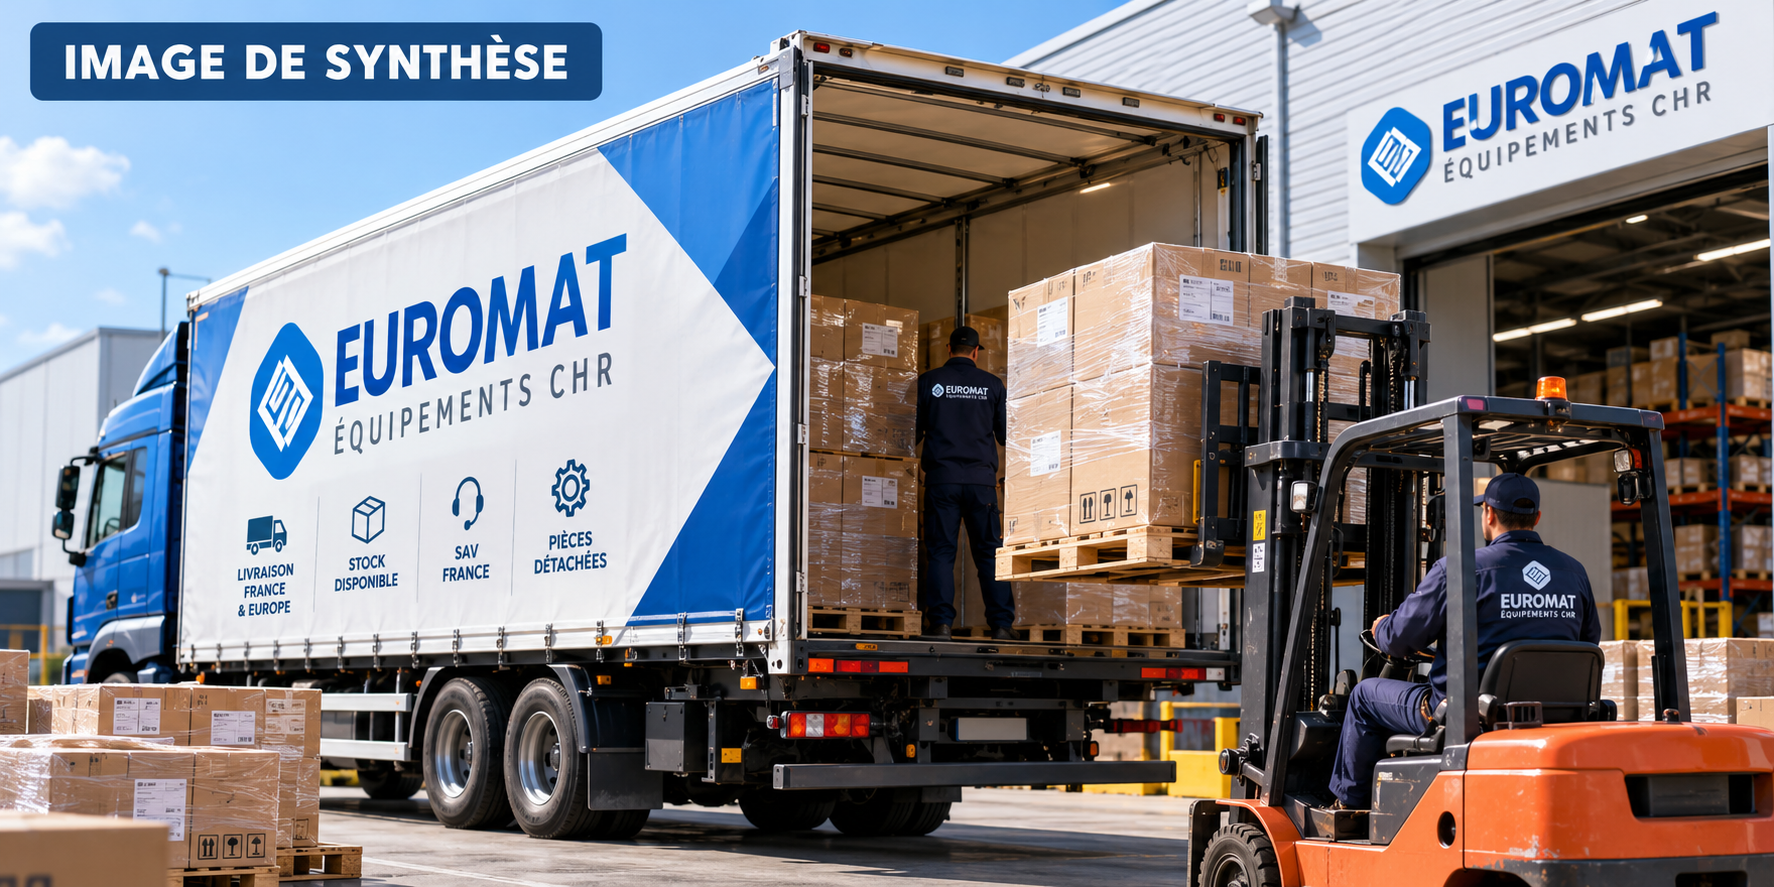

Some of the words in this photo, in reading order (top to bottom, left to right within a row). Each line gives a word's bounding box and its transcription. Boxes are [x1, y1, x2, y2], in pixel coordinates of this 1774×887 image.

[1442, 11, 1719, 153] EUROMAT
[1443, 104, 1635, 183] ÉQUIPEMENTS
[1652, 82, 1711, 117] CHR
[335, 233, 627, 408] EUROMAT
[945, 385, 988, 396] EUROMAT
[333, 373, 531, 455] ÉQUIPEMENTS
[551, 353, 612, 399] CHR
[548, 530, 593, 551] PIÈCES
[454, 543, 479, 560] SAV
[348, 554, 386, 572] STOCK
[534, 550, 608, 575] DÉTACHÉES
[237, 563, 295, 582] LIVRAISON
[442, 564, 490, 583] FRANCE
[243, 583, 286, 599] FRANCE
[334, 573, 399, 592] DISPONIBLE
[237, 604, 247, 617] &
[248, 601, 291, 617] EUROPE
[1501, 593, 1577, 609] EUROMAT
